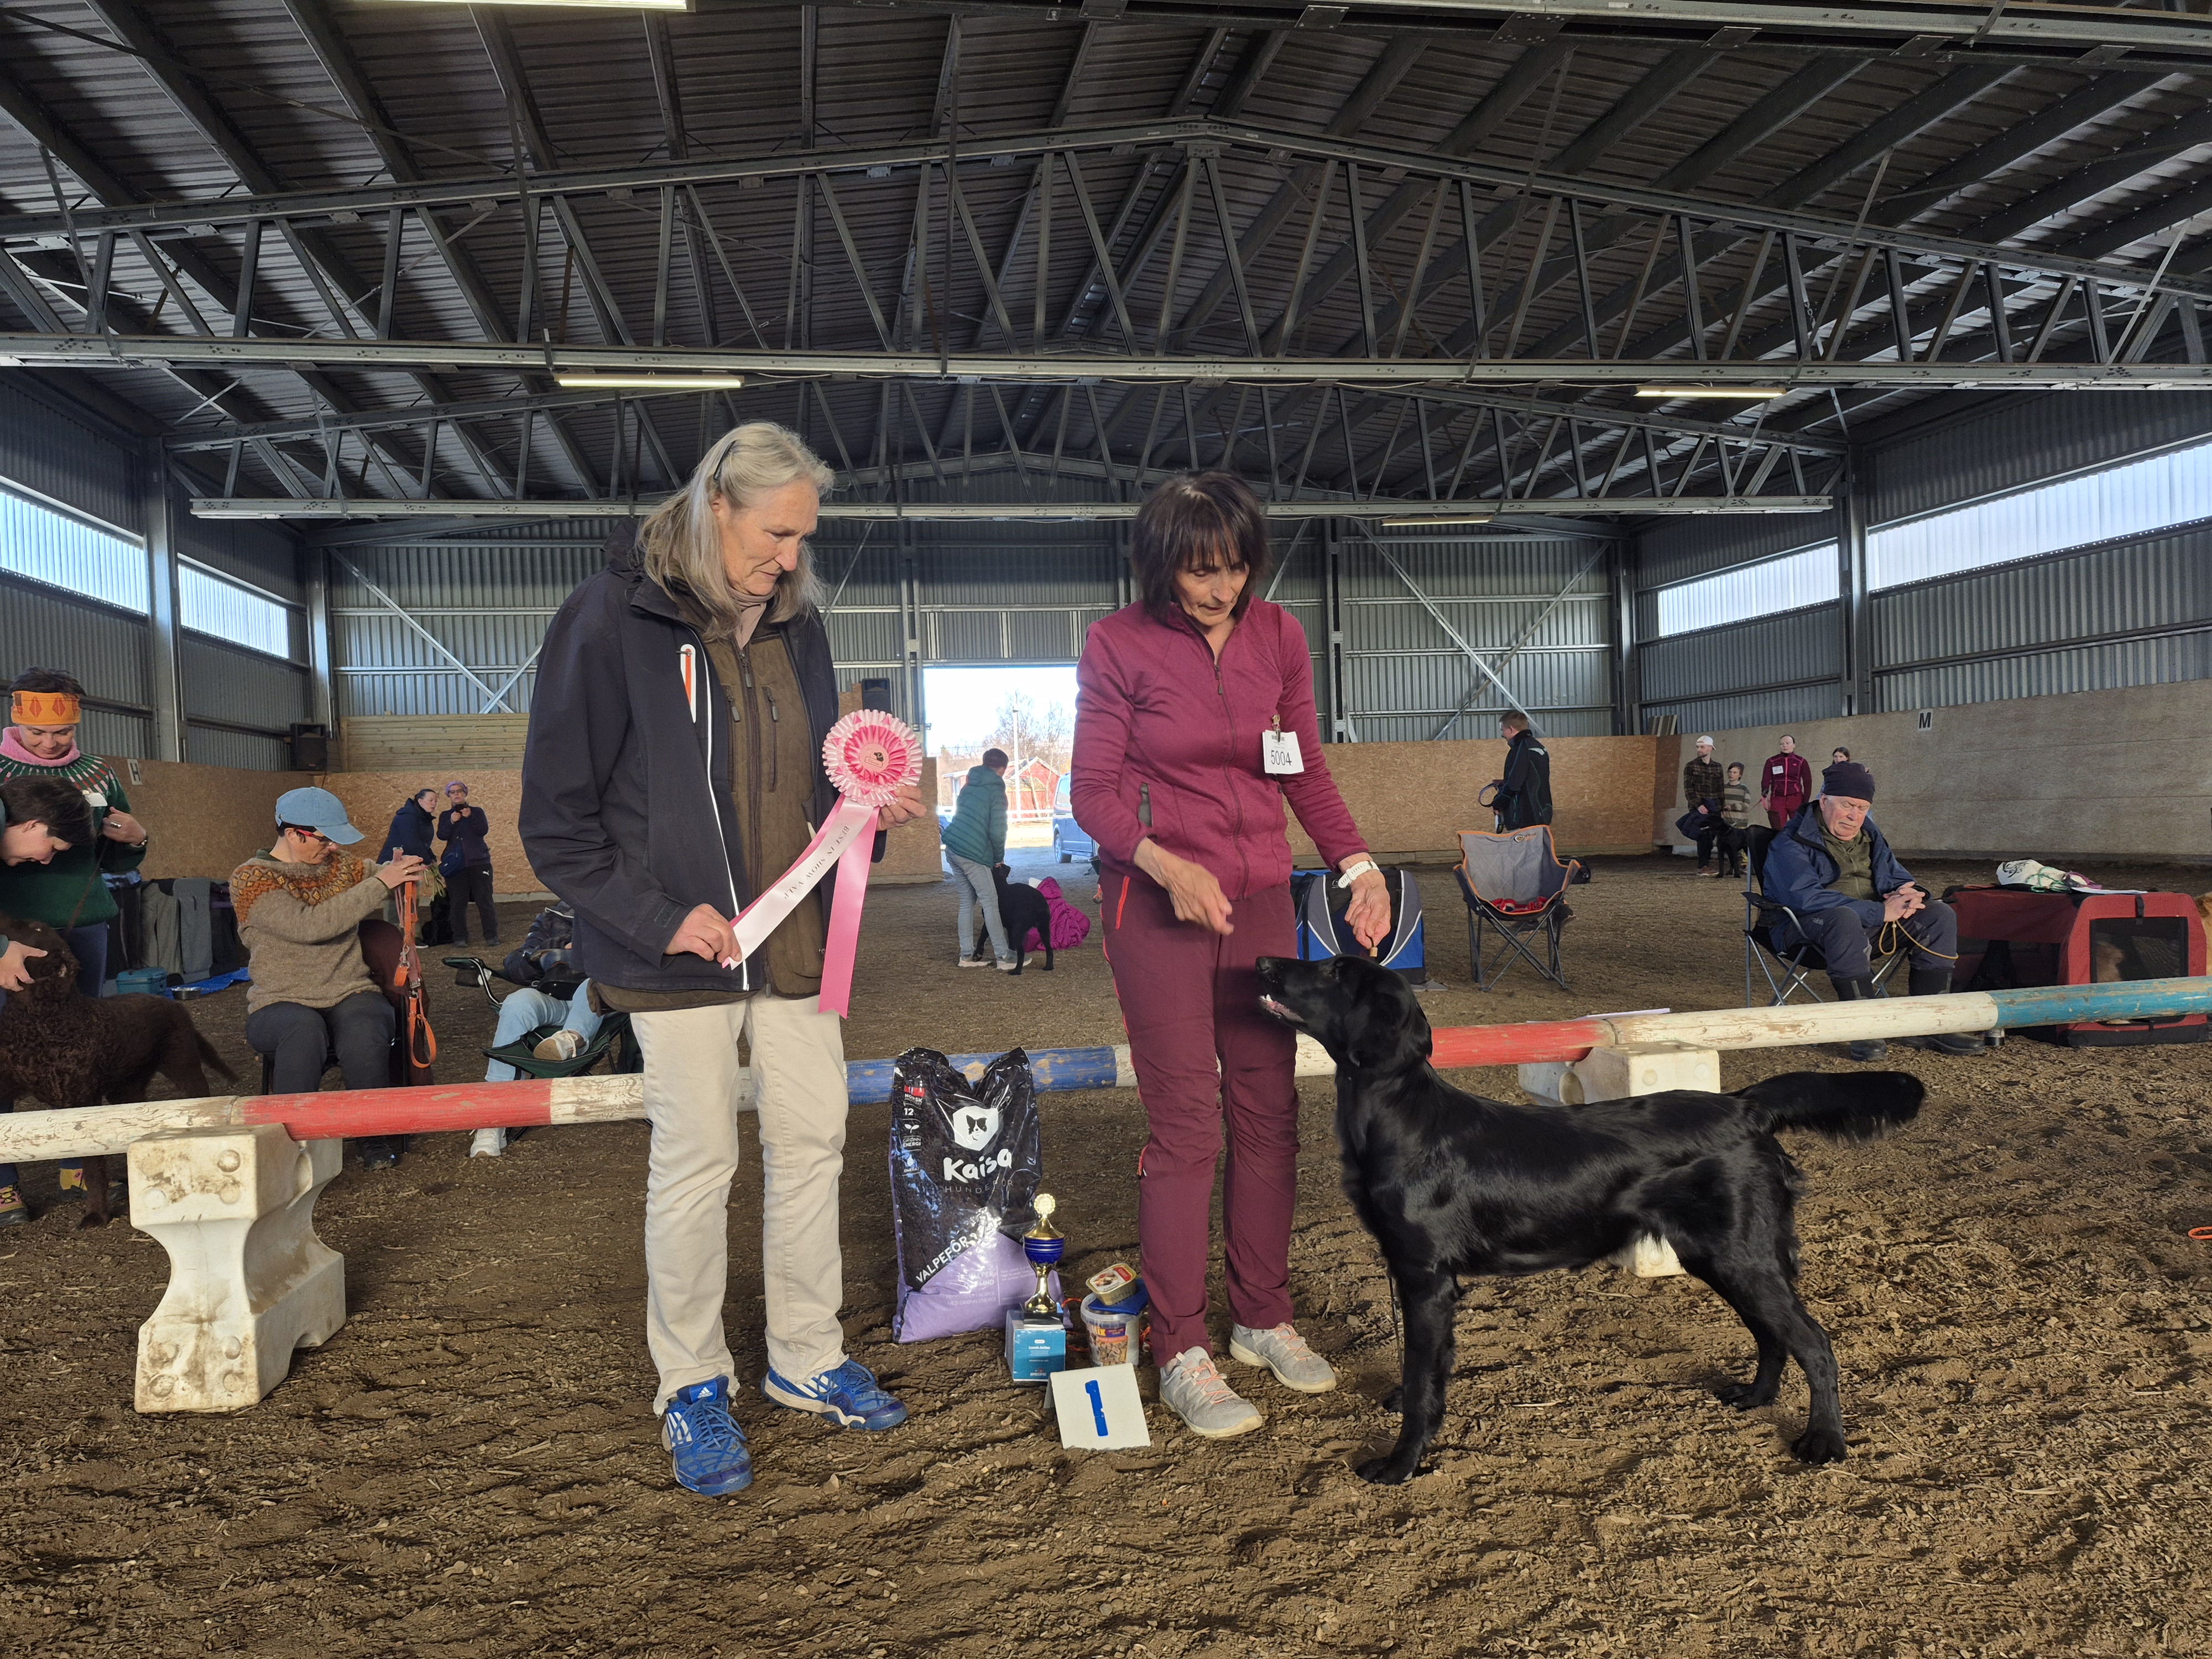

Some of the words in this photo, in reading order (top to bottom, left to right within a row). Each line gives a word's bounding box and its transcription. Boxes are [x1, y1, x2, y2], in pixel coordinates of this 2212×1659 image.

[1919, 712, 1931, 729] M
[1271, 750, 1292, 766] 5004
[130, 763, 141, 781] H
[836, 826, 850, 846] BEST
[827, 846, 835, 857] IN
[806, 857, 826, 880] SHOW
[784, 881, 804, 899] VALP
[904, 1093, 923, 1103] NORSK
[904, 1108, 914, 1116] 12
[943, 1148, 1012, 1183] Kaisa
[1085, 1379, 1109, 1437] 1
